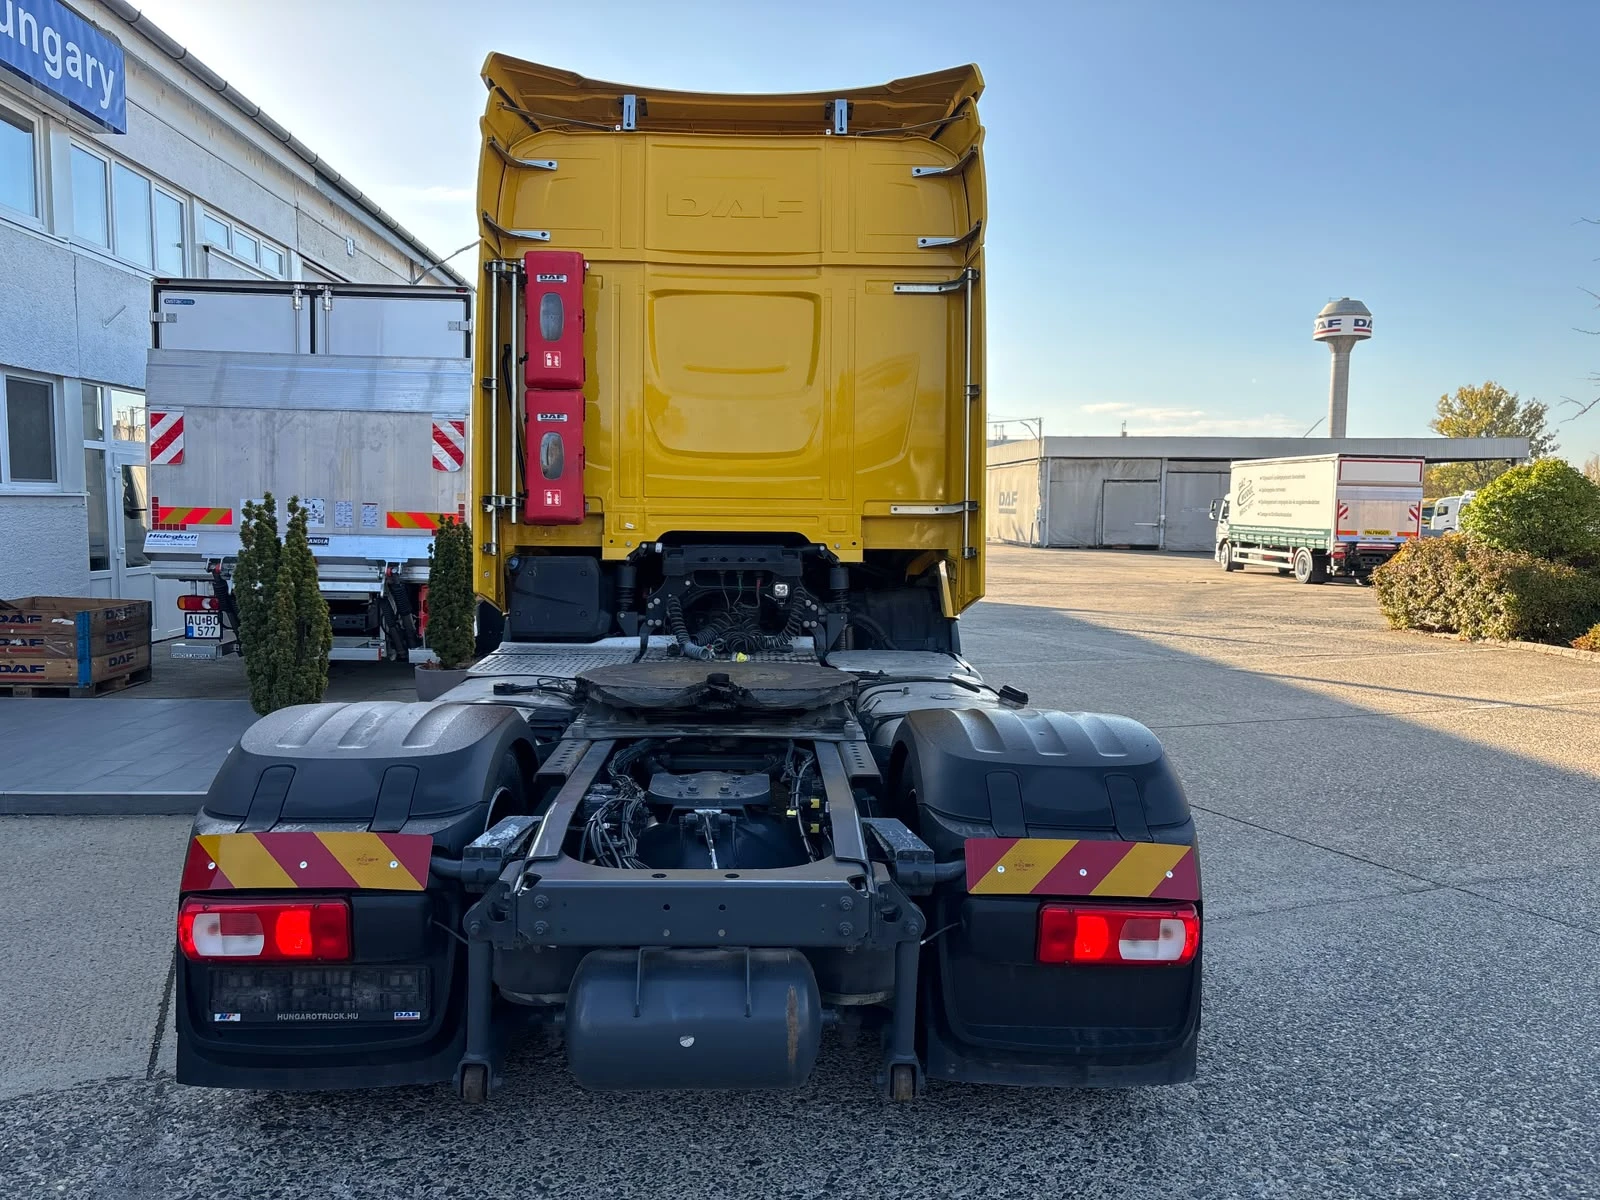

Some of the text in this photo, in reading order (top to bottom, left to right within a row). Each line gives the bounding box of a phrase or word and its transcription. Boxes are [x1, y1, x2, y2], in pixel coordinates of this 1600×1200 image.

[666, 189, 804, 219] DAF
[1315, 318, 1342, 330] AF
[998, 491, 1018, 507] DAF
[188, 615, 202, 626] AU
[106, 630, 132, 643] DAF
[197, 626, 216, 636] 577
[109, 652, 134, 667] DAF
